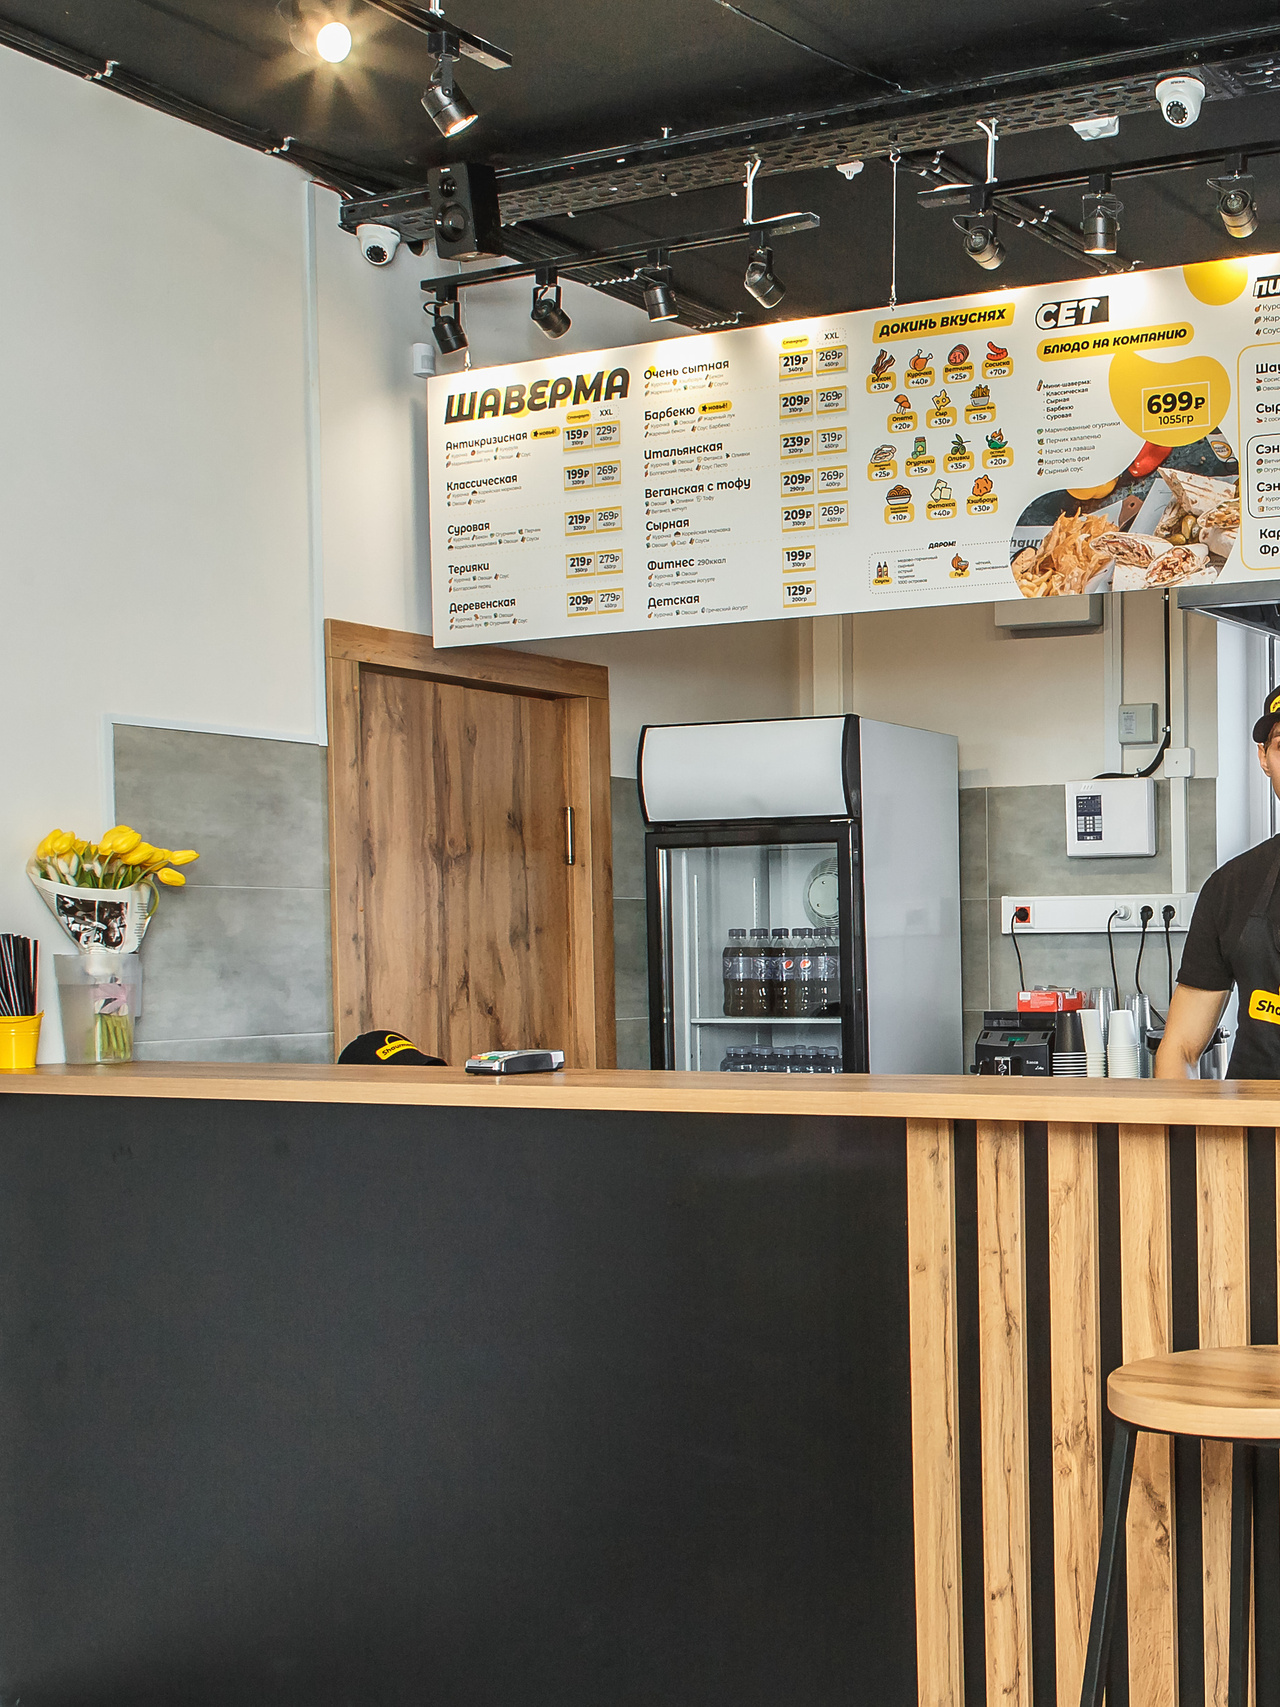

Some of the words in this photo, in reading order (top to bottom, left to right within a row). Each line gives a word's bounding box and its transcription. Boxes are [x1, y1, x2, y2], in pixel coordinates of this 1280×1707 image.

[1035, 299, 1100, 329] СЕТ
[879, 319, 936, 337] ДОКИНЬ
[940, 309, 1006, 327] ВКУСНЯХ
[1263, 327, 1280, 335] Соус
[1043, 340, 1089, 355] БЛЮДО
[1093, 339, 1109, 349] НА
[1112, 328, 1187, 347] КОМПАНИЮ
[644, 369, 679, 380] Очень
[682, 360, 729, 374] сытная
[444, 367, 630, 424] ШАВЕРМА
[600, 409, 613, 417] XXL
[644, 405, 695, 422] Барбекю
[1158, 415, 1194, 425] 1055гр
[446, 432, 527, 451] Антикризисная
[644, 443, 723, 460] Итальянская
[446, 475, 517, 491] Классическая
[644, 485, 704, 498] Веганская
[707, 483, 714, 492] с
[717, 478, 751, 491] тофу
[447, 522, 490, 536] Суровая
[645, 519, 689, 533] Сырная
[928, 541, 956, 549] ДАРОМ!
[448, 563, 489, 576] Терияки
[647, 557, 694, 571] Фитнес
[449, 598, 516, 614] Деревенская
[648, 594, 699, 609] Детская
